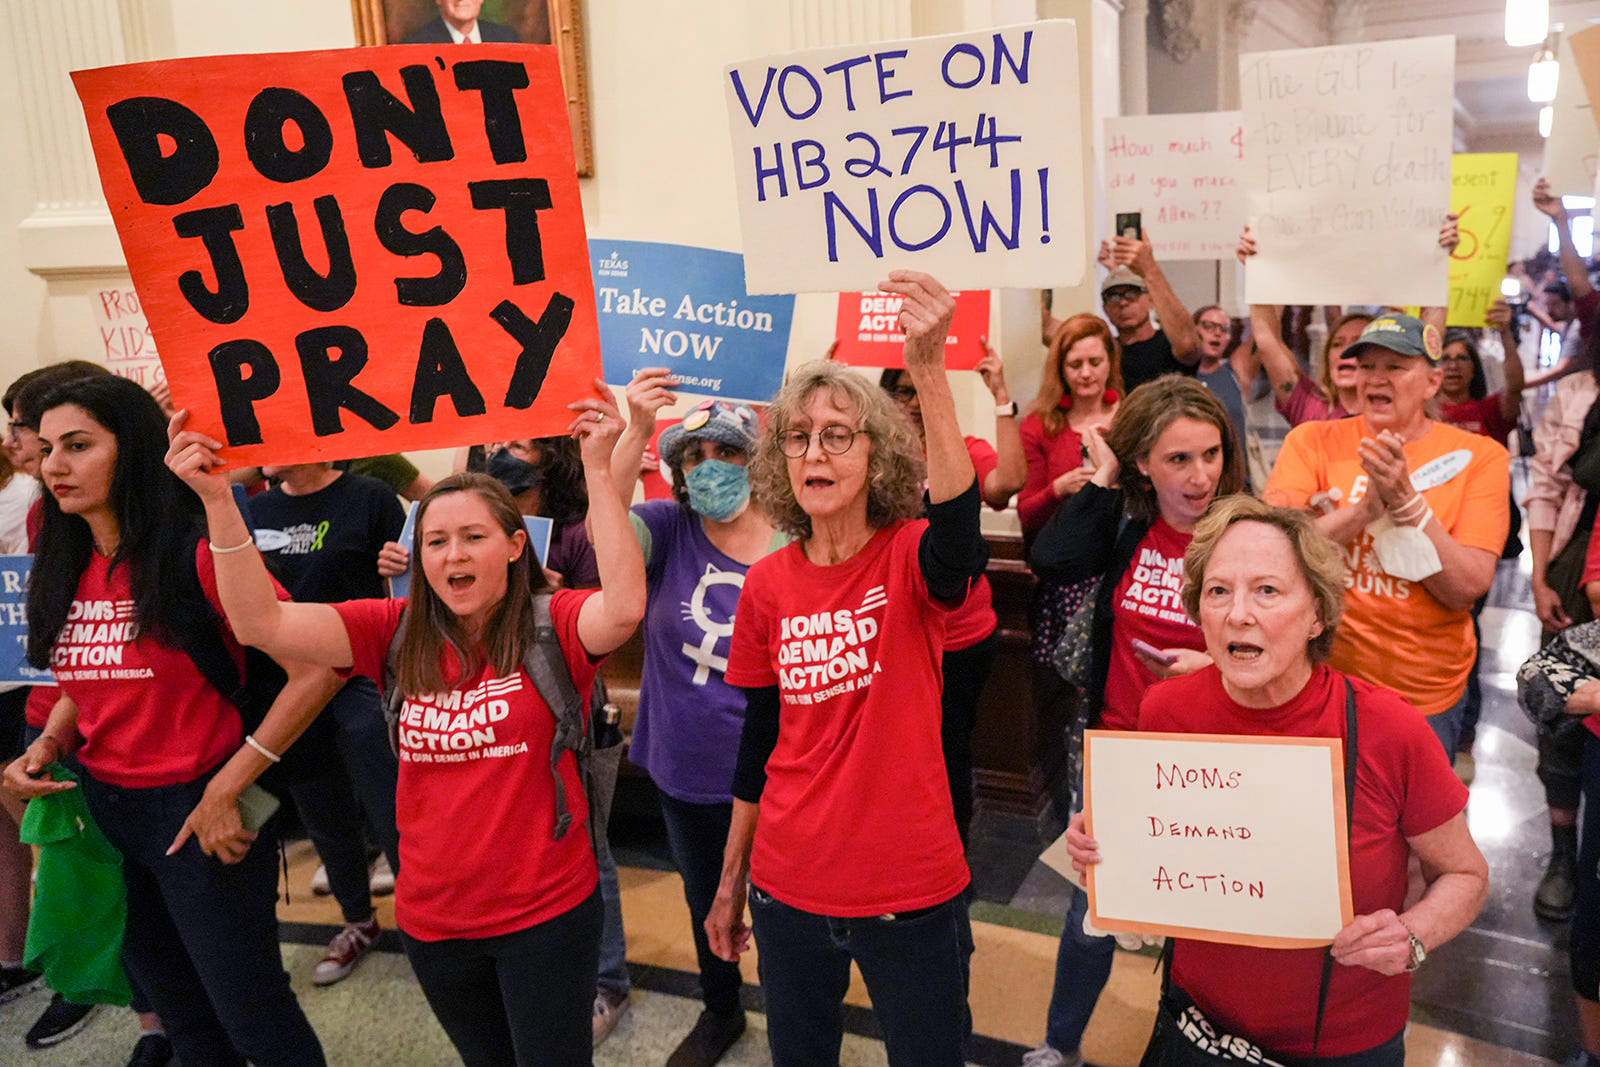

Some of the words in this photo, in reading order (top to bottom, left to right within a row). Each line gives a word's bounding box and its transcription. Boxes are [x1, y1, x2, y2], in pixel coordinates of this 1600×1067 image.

[730, 50, 913, 128] VOTE
[941, 31, 1034, 89] ON
[1242, 54, 1304, 101] The
[106, 57, 530, 206] DON'T
[753, 139, 831, 201] HB
[844, 113, 1022, 178] 2744
[1108, 135, 1153, 158] How
[1168, 137, 1212, 154] much
[1265, 144, 1365, 193] EVERY
[1369, 141, 1448, 188] death
[1452, 171, 1497, 187] esent
[1111, 172, 1136, 189] did
[1151, 177, 1177, 198] you
[823, 168, 1051, 262] NOW!
[171, 179, 553, 324] JUST
[599, 259, 629, 270] TEXAS
[100, 289, 141, 321] PRO
[599, 287, 667, 317] Take
[673, 294, 774, 333] Action
[860, 297, 903, 314] DEM
[1452, 287, 1492, 313] 744
[858, 315, 901, 332] ACT
[638, 327, 724, 362] NOW
[208, 292, 575, 447] PRAY
[632, 368, 723, 392] tense.org
[1139, 547, 1185, 575] MOM
[1132, 565, 1185, 594] DEM
[1125, 582, 1184, 609] ACTI
[0, 603, 29, 626] TH
[66, 600, 116, 621] OMS
[58, 621, 141, 644] EMAND
[51, 645, 124, 666] CTION
[778, 647, 869, 690] ACTION
[111, 668, 155, 680] AMERICA
[407, 690, 481, 711] MS
[400, 699, 510, 732] DEMAND
[400, 726, 497, 751] ACTION
[412, 752, 433, 763] GUN
[434, 752, 468, 763] SENSE
[469, 749, 481, 760] IN
[482, 741, 528, 759] AMERICA
[1155, 762, 1242, 790] MOMS
[1147, 816, 1252, 840] DEMAND
